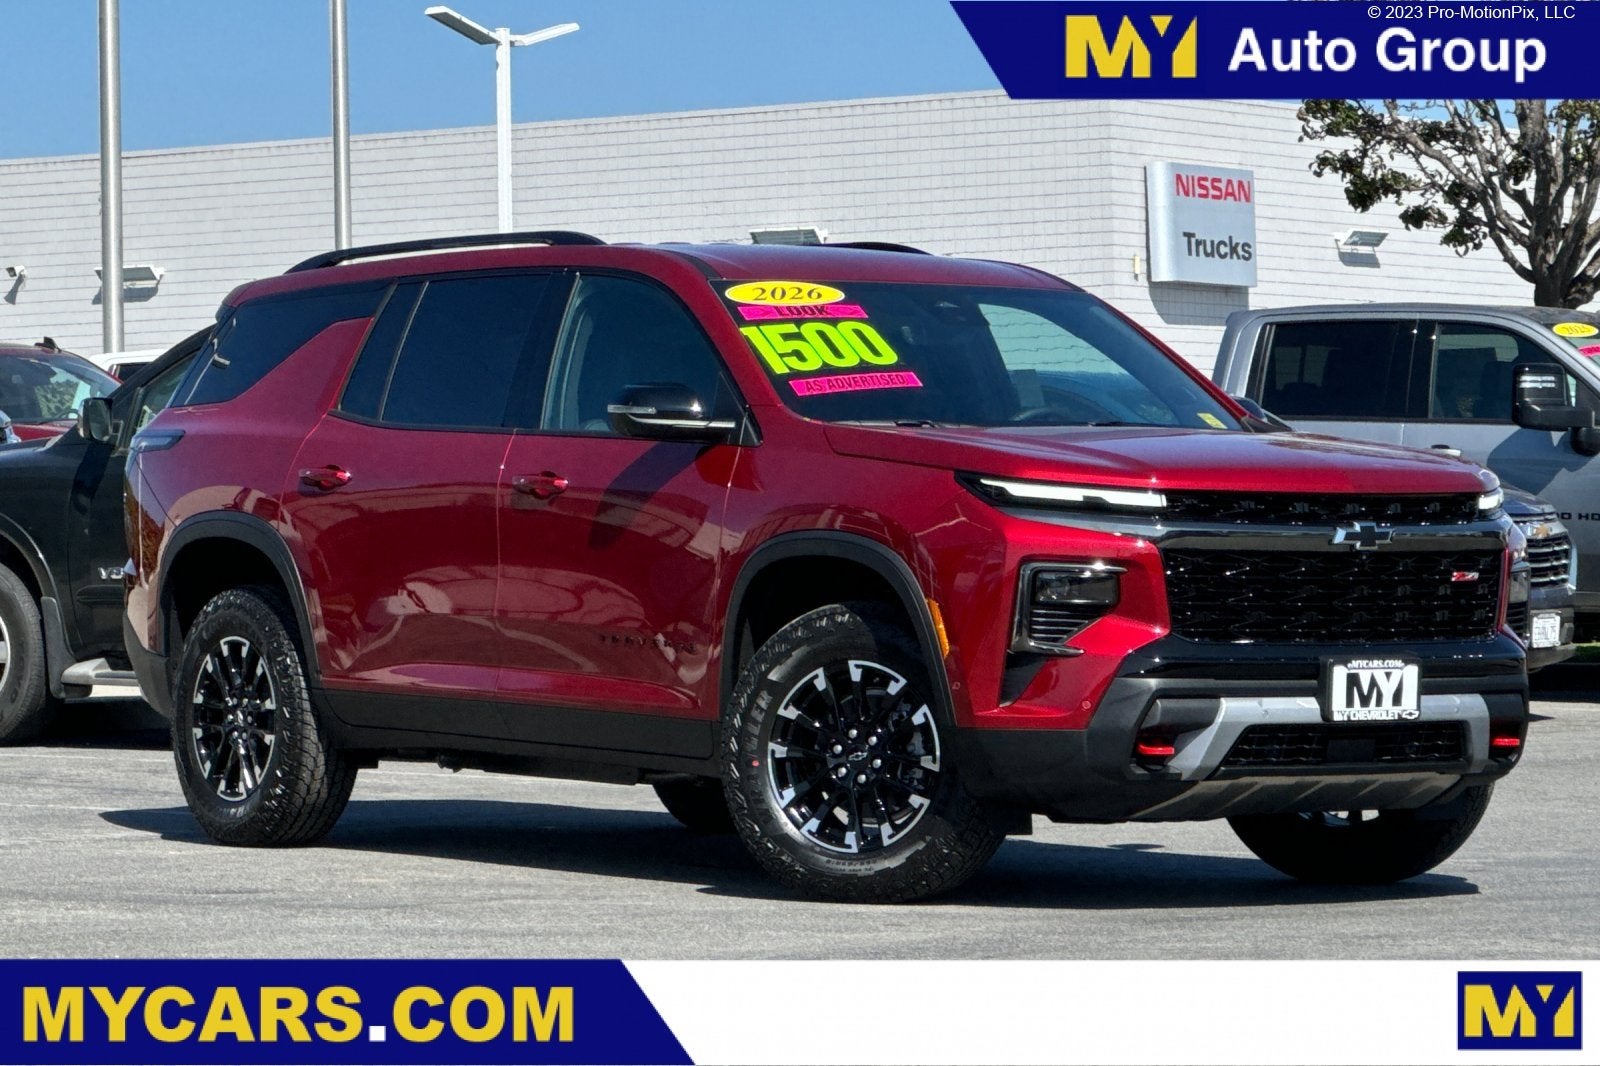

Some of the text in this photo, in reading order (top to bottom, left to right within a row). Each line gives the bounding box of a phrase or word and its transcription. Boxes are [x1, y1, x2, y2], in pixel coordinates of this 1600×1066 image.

[1175, 173, 1251, 203] NISSAN
[1182, 231, 1253, 261] Trucks
[752, 286, 823, 301] 2026
[775, 305, 829, 317] LOOK
[740, 321, 899, 375] 1500
[804, 373, 907, 393] AS ADVERTISED
[1346, 671, 1404, 709] MY
[1350, 710, 1399, 721] CHEVROLET
